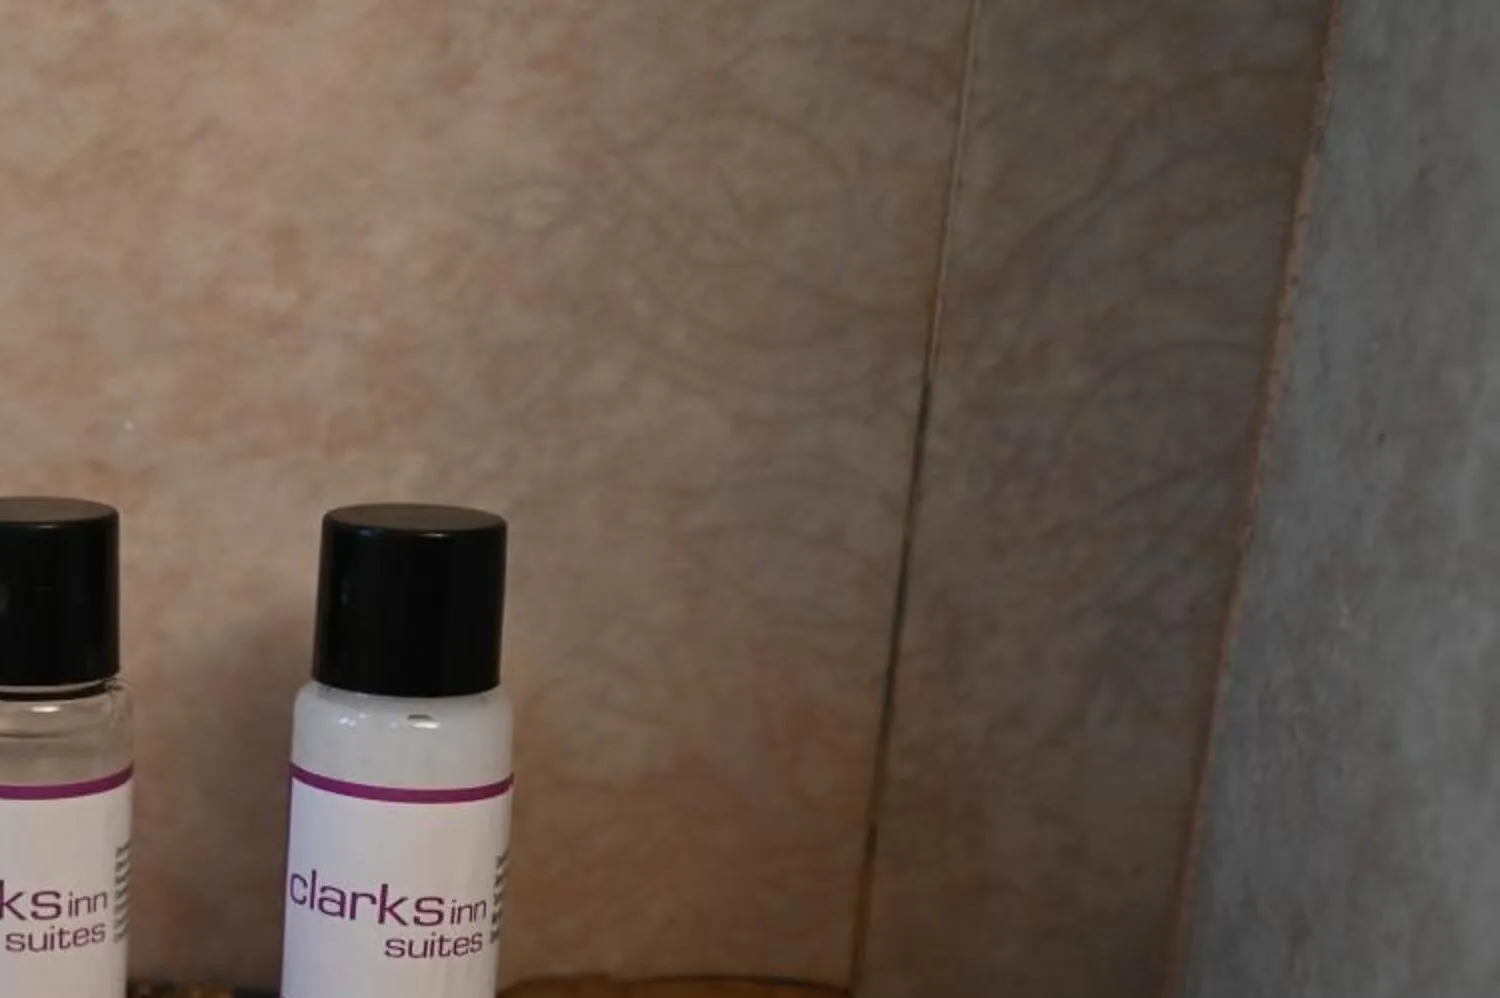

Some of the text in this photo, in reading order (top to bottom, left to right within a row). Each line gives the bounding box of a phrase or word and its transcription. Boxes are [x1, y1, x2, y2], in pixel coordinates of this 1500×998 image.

[68, 890, 108, 919] inn
[289, 869, 445, 928] clarks
[450, 899, 488, 926] inn
[5, 923, 106, 953] suites
[385, 931, 483, 960] suites
